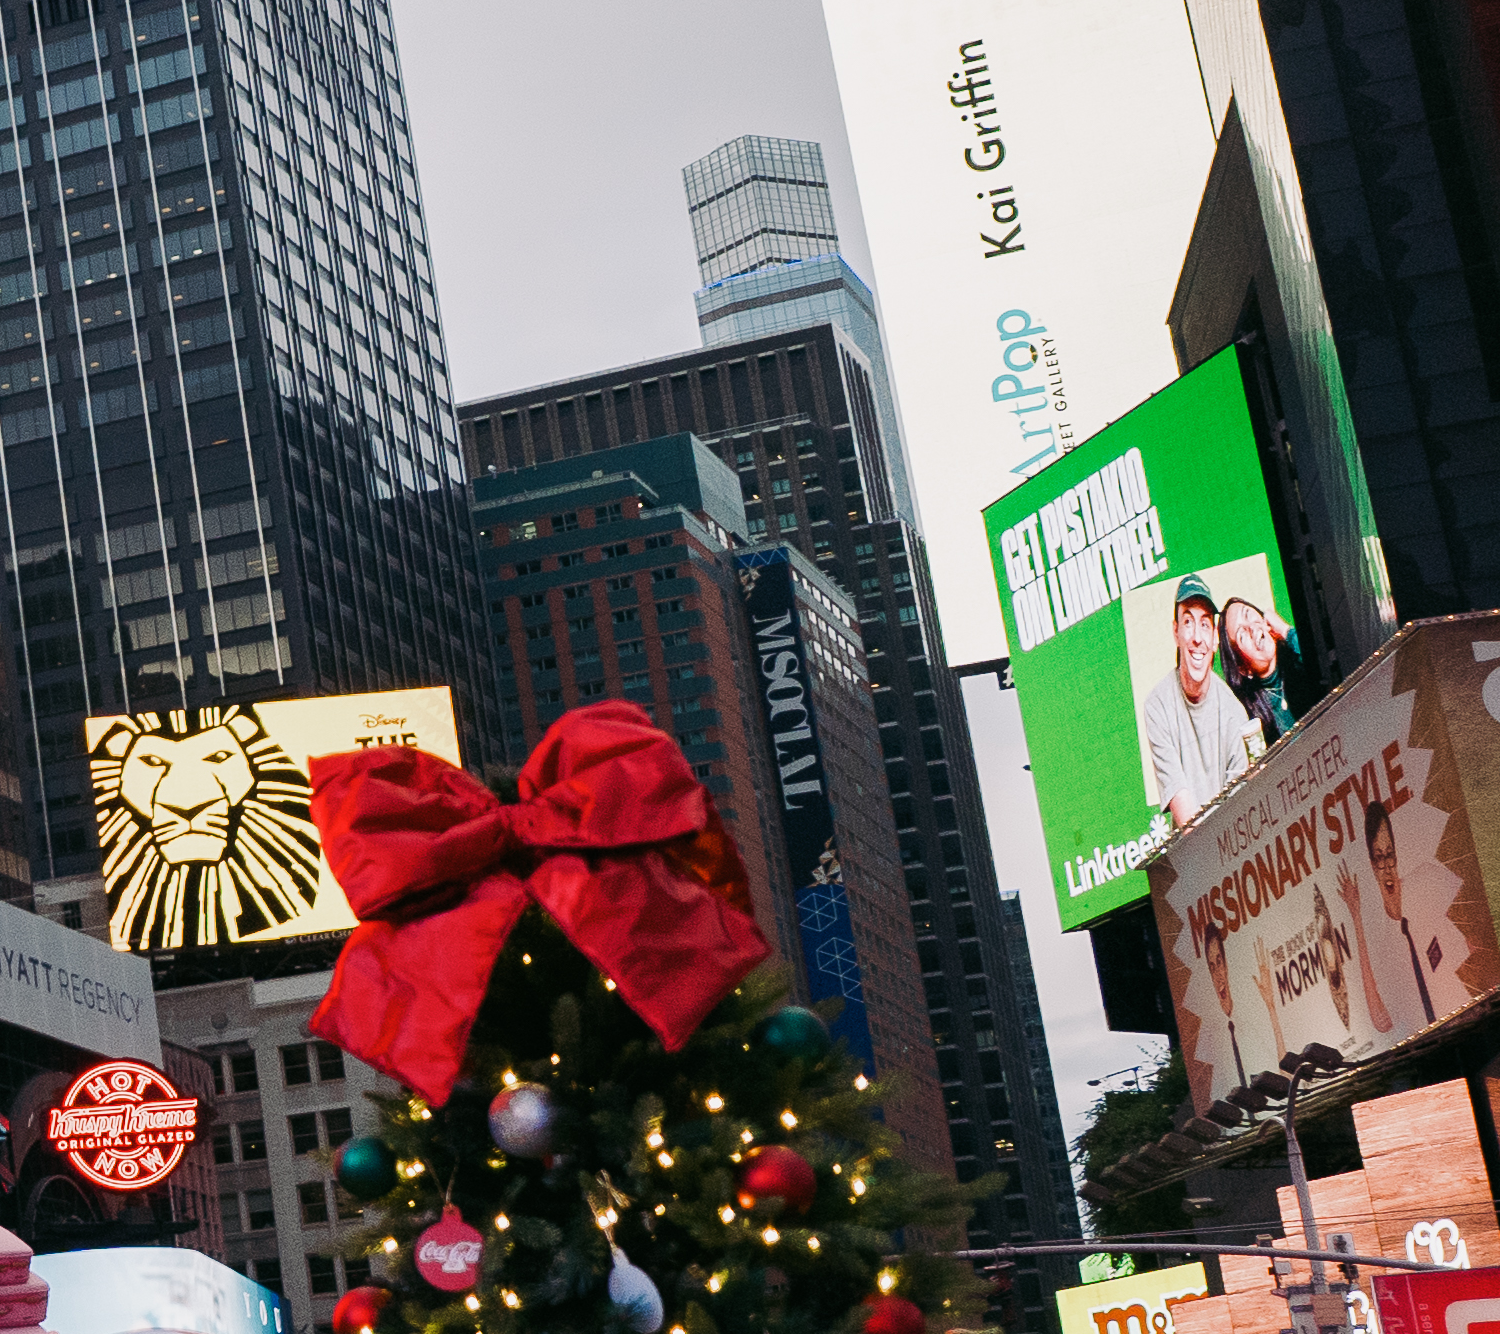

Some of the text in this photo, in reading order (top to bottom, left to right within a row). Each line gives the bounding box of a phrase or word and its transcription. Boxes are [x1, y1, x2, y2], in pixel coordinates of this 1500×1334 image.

[947, 38, 1026, 259] Kai Griffin
[991, 307, 1060, 479] ArtPop
[1043, 336, 1070, 414] GALLERY
[1001, 446, 1151, 593] GET PISTAKIO
[1011, 505, 1169, 653] ON LINKTREE!
[1217, 805, 1279, 858] MUSICAL
[1186, 806, 1324, 959] MISSIONARY
[58, 968, 141, 1025] REGENCY
[88, 1071, 151, 1100] HOT
[50, 1098, 198, 1139] Krispy Kreme
[57, 1130, 196, 1151] ORIGINAL GLAZED
[93, 1147, 166, 1180] NOW
[1418, 1302, 1429, 1311] a
